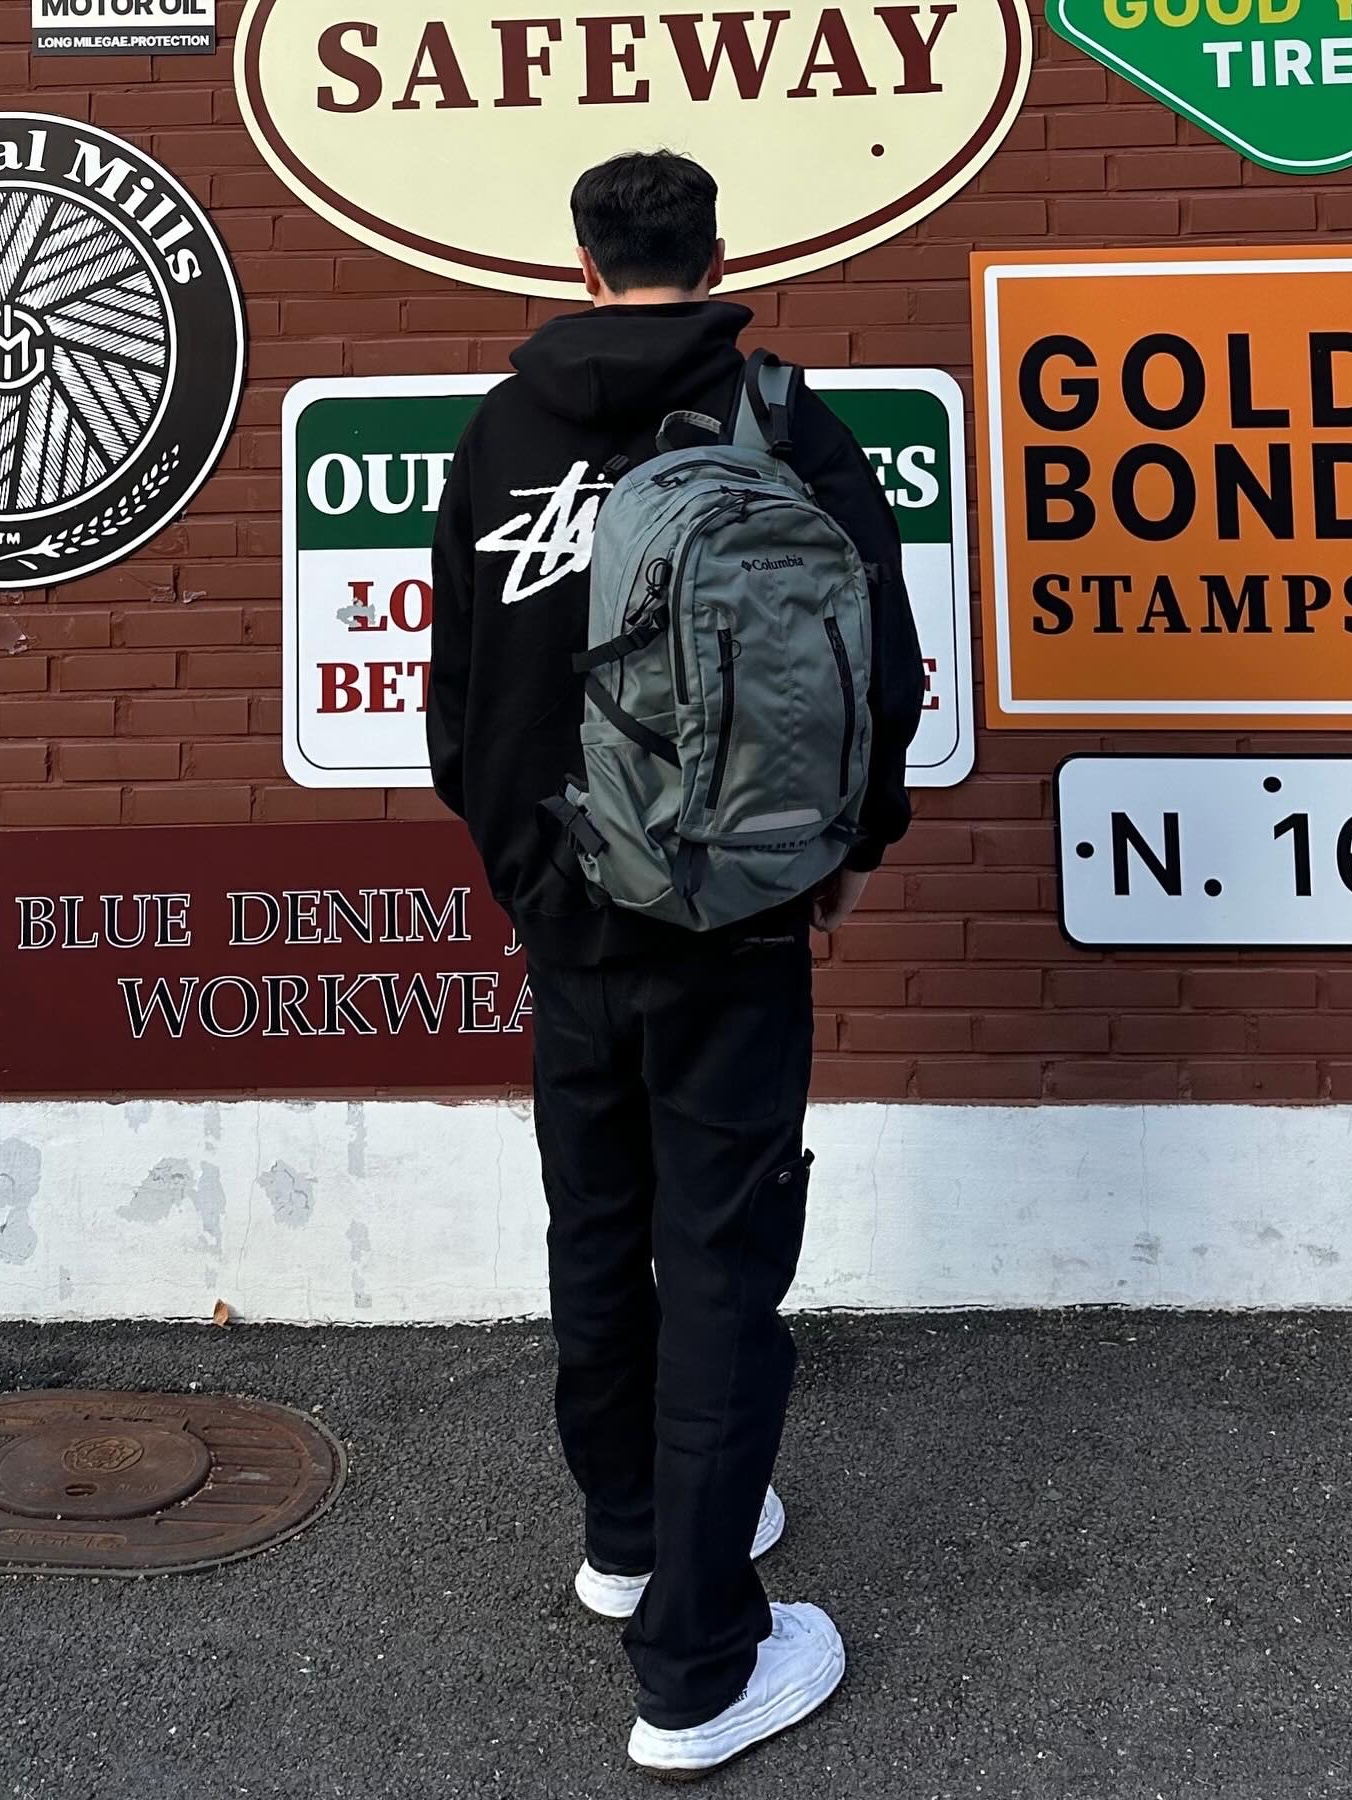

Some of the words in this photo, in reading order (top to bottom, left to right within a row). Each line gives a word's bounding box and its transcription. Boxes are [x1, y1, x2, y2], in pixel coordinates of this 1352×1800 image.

[38, 37, 72, 48] LONG
[317, 4, 958, 113] SAFEWAY
[1202, 38, 1352, 88] TIRE
[63, 139, 202, 284] Mills
[752, 555, 804, 572] Columbia
[1032, 573, 1352, 635] STAMP
[1111, 812, 1222, 897] N.
[1274, 813, 1352, 897] 1
[15, 894, 192, 949] BLUE
[227, 887, 471, 946] DENIM
